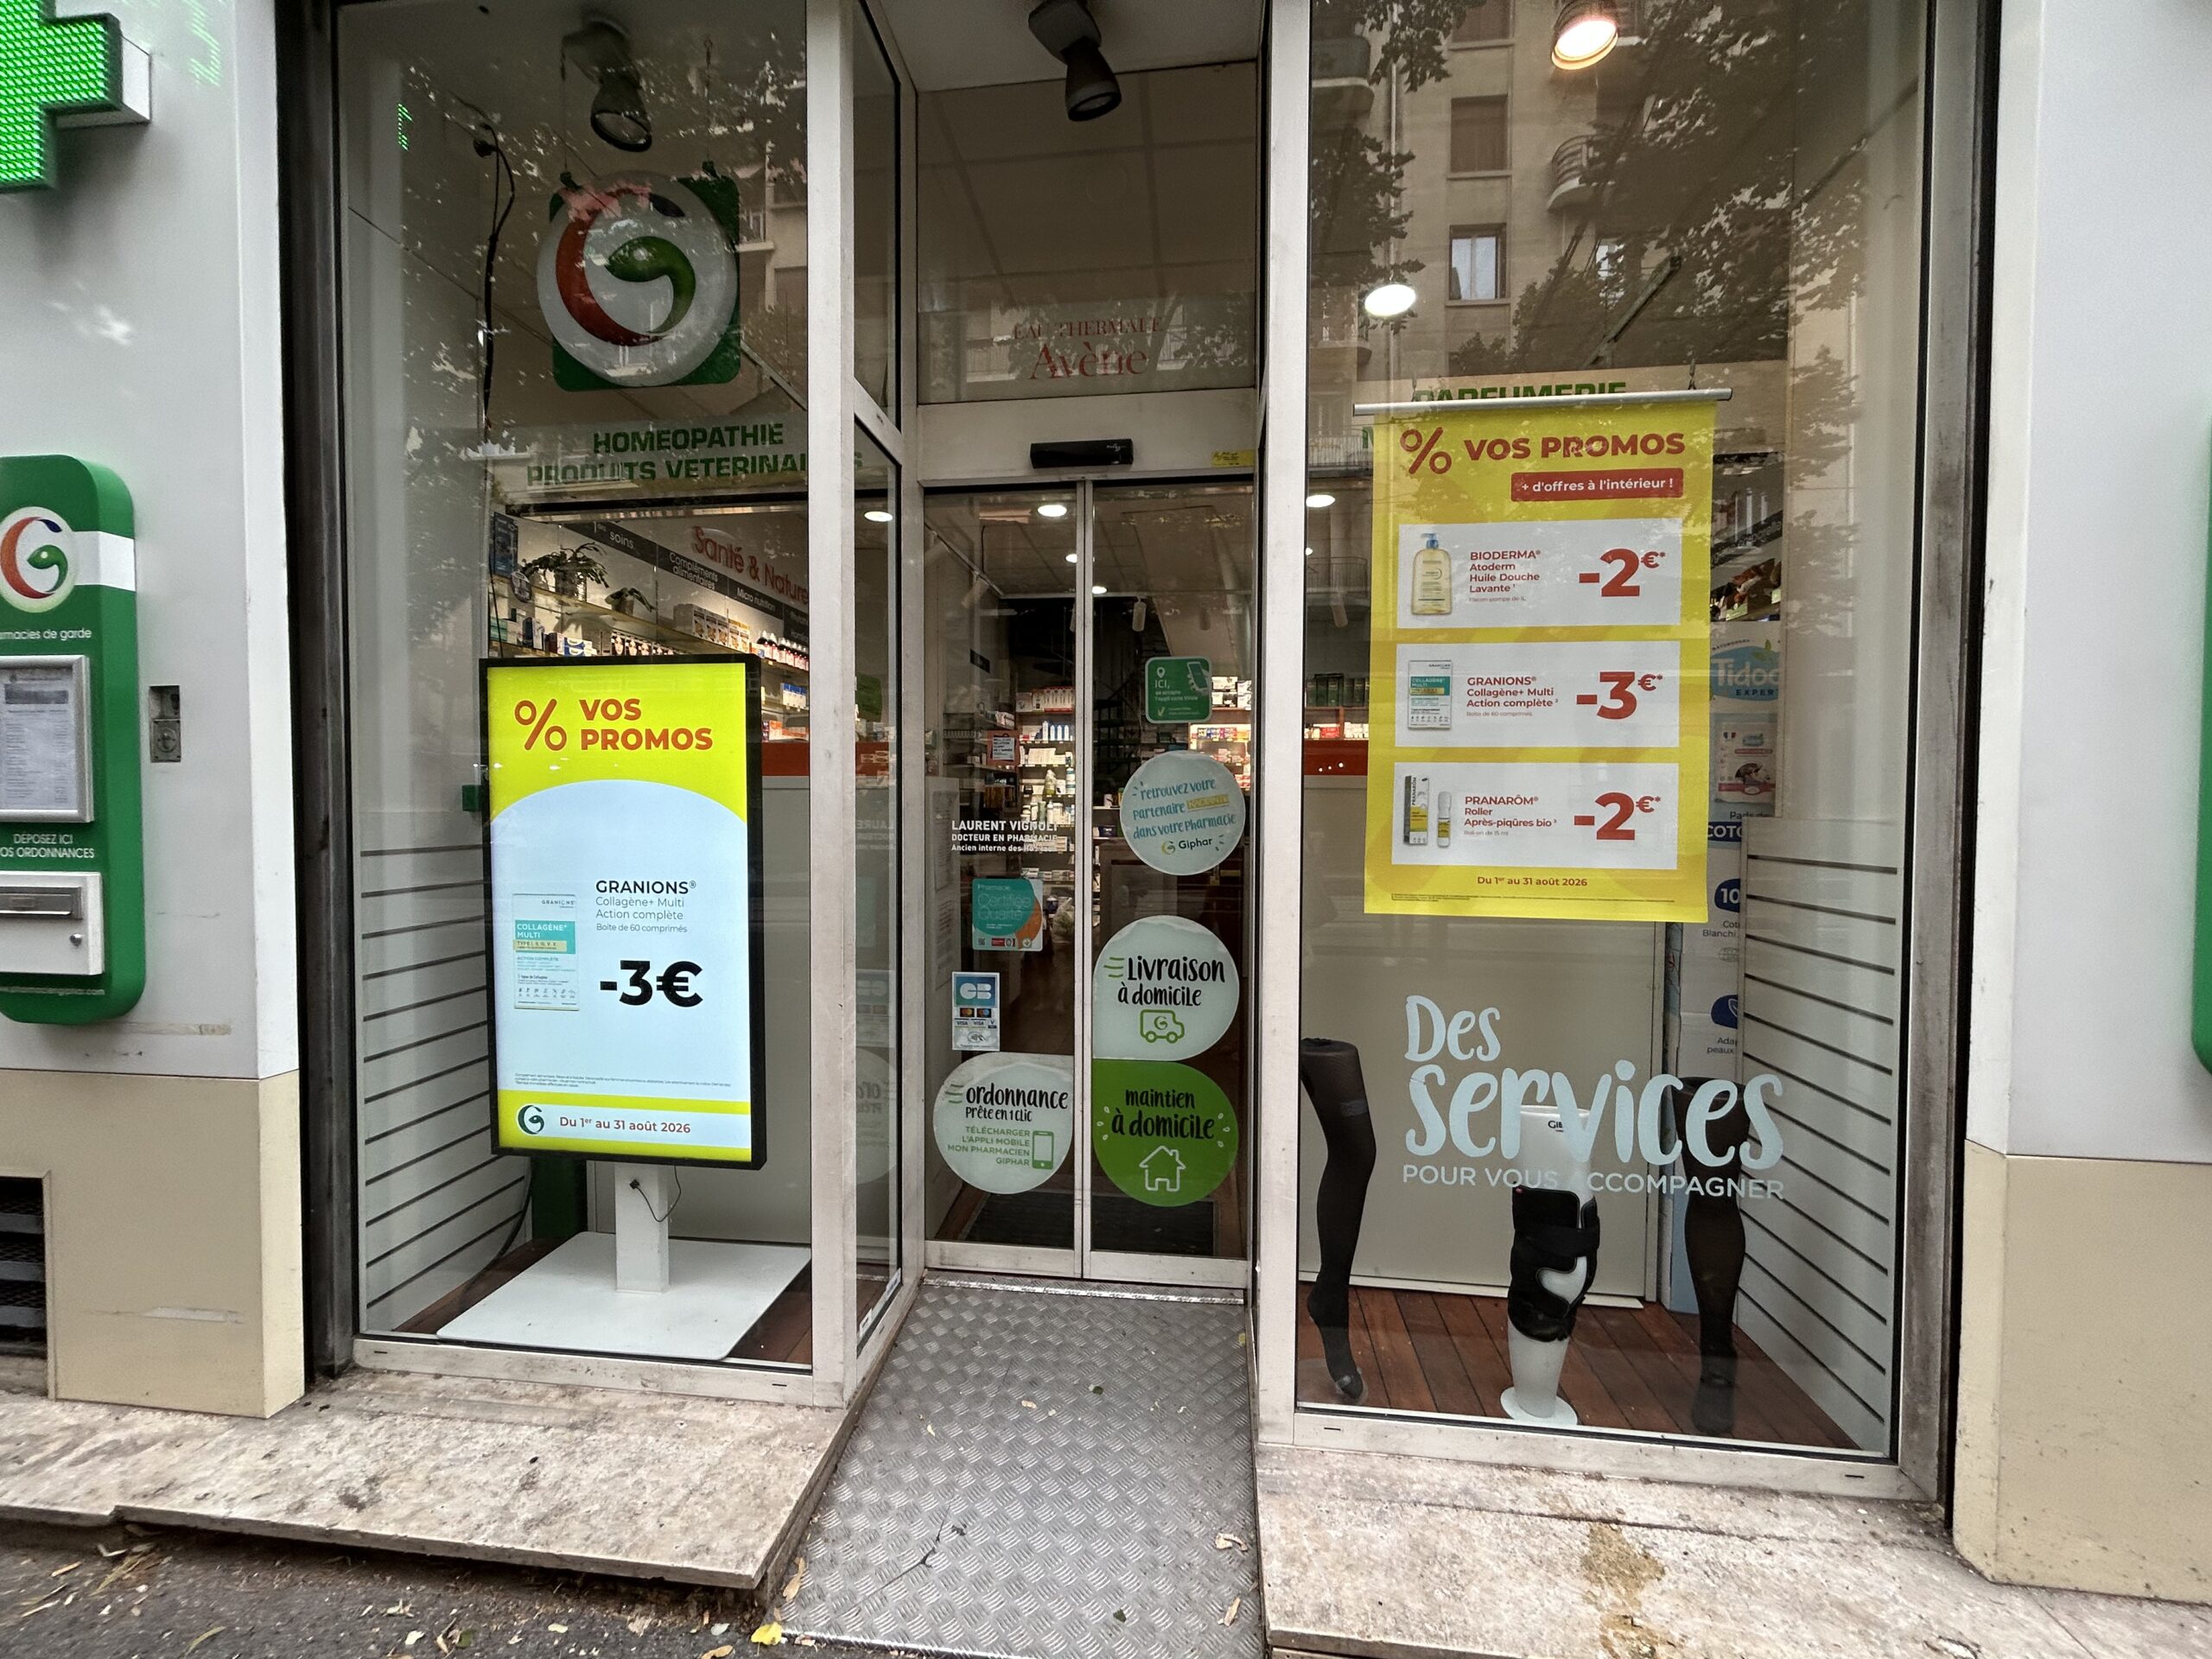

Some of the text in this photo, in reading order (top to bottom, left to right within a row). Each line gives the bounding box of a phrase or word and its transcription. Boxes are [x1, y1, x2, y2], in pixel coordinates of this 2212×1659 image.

[1028, 341, 1148, 380] Avène
[594, 423, 783, 454] HOMEOPATHIE
[1464, 437, 1530, 461] VOS
[1541, 433, 1686, 458] PROMOS
[1533, 480, 1585, 493] d'offres
[1587, 478, 1596, 491] à
[1599, 477, 1668, 491] l'intérieur
[609, 530, 634, 550] soins
[693, 525, 745, 574] Santé
[1470, 563, 1516, 572] Atoderm
[1470, 573, 1540, 582] Huile Douche
[1470, 584, 1510, 594] Lavante
[43, 629, 57, 639] de
[60, 627, 92, 640] garde
[1466, 687, 1554, 697] Collagène+ Multi
[579, 698, 641, 721] VOS
[1466, 698, 1554, 709] Action complète
[581, 728, 713, 750] PROMOS
[1141, 779, 1217, 800] retrouvez votre
[1465, 807, 1493, 817] Roller
[951, 820, 1006, 830] LAURENT
[1464, 817, 1552, 829] Après-piqûres bio
[951, 833, 991, 842] DOCTEUR
[1134, 826, 1157, 840] dans
[1158, 822, 1184, 836] votre
[1178, 838, 1213, 850] Giphar
[0, 847, 95, 859] OS ORDONNANCES
[1477, 876, 1492, 885] Du
[1522, 877, 1533, 886] 31
[1535, 876, 1560, 886] août
[1562, 878, 1587, 887] 2026
[595, 896, 684, 909] Collagène+ Multi
[595, 909, 683, 922] Action complète
[618, 923, 628, 931] de
[630, 924, 640, 932] 60
[641, 924, 688, 934] comprimés
[1127, 955, 1225, 983] Livraison
[600, 960, 703, 1007] -3€
[1117, 982, 1128, 1005] à
[1404, 995, 1501, 1062] Des
[966, 1082, 1069, 1109] ordonnance
[1125, 1088, 1196, 1110] maintien
[995, 1109, 1007, 1120] en
[1111, 1107, 1125, 1135] à
[1406, 1059, 1784, 1170] services
[560, 1116, 577, 1128] Du
[594, 1119, 611, 1129] au
[613, 1119, 626, 1130] 31
[628, 1119, 658, 1131] août
[661, 1122, 691, 1133] 2026
[965, 1126, 1030, 1137] TÉLÉCHARGER
[962, 1135, 1030, 1147] L'APPLI MOBILE
[970, 1145, 1030, 1156] PHARMACIEN
[995, 1157, 1030, 1166] GIPHAR
[1402, 1164, 1784, 1200] POUR VOUS CCOMPAGNER
